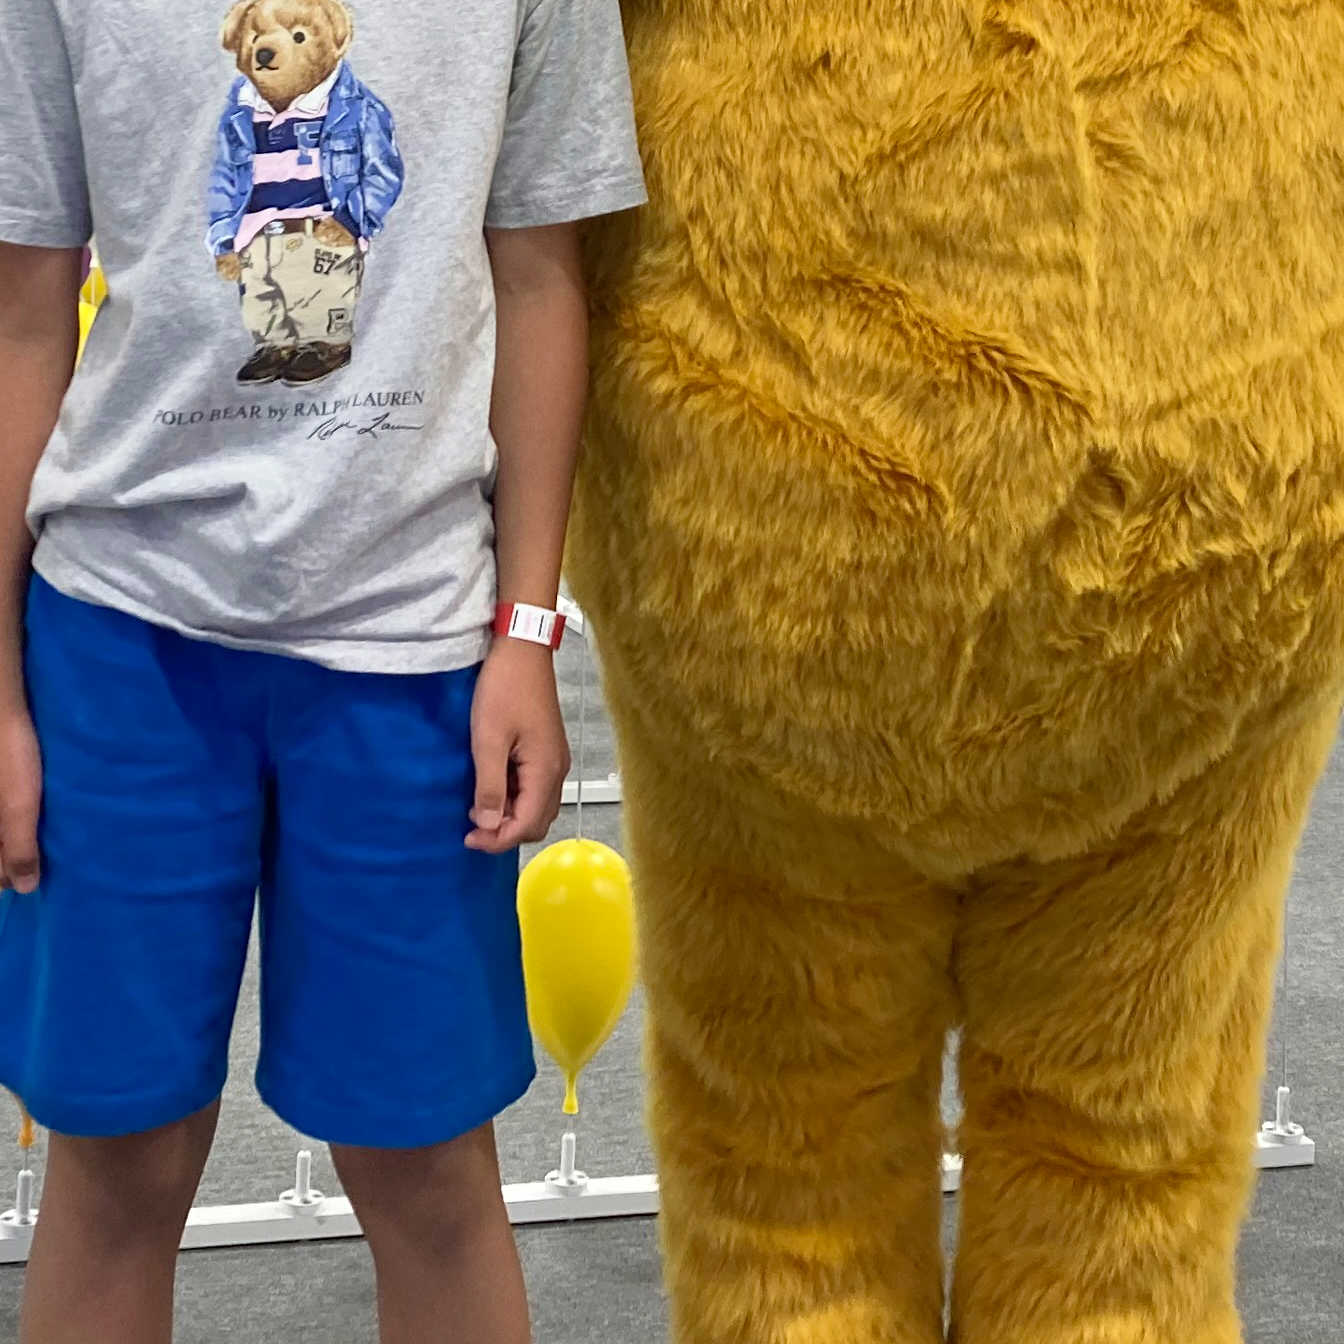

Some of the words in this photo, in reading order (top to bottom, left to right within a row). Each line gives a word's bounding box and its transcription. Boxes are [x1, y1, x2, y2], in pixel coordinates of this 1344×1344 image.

[313, 256, 336, 275] 67
[152, 408, 204, 425] POLO
[209, 404, 262, 422] BEAR
[268, 405, 289, 422] by
[294, 398, 351, 417] RALPH
[352, 390, 424, 407] LAUREN
